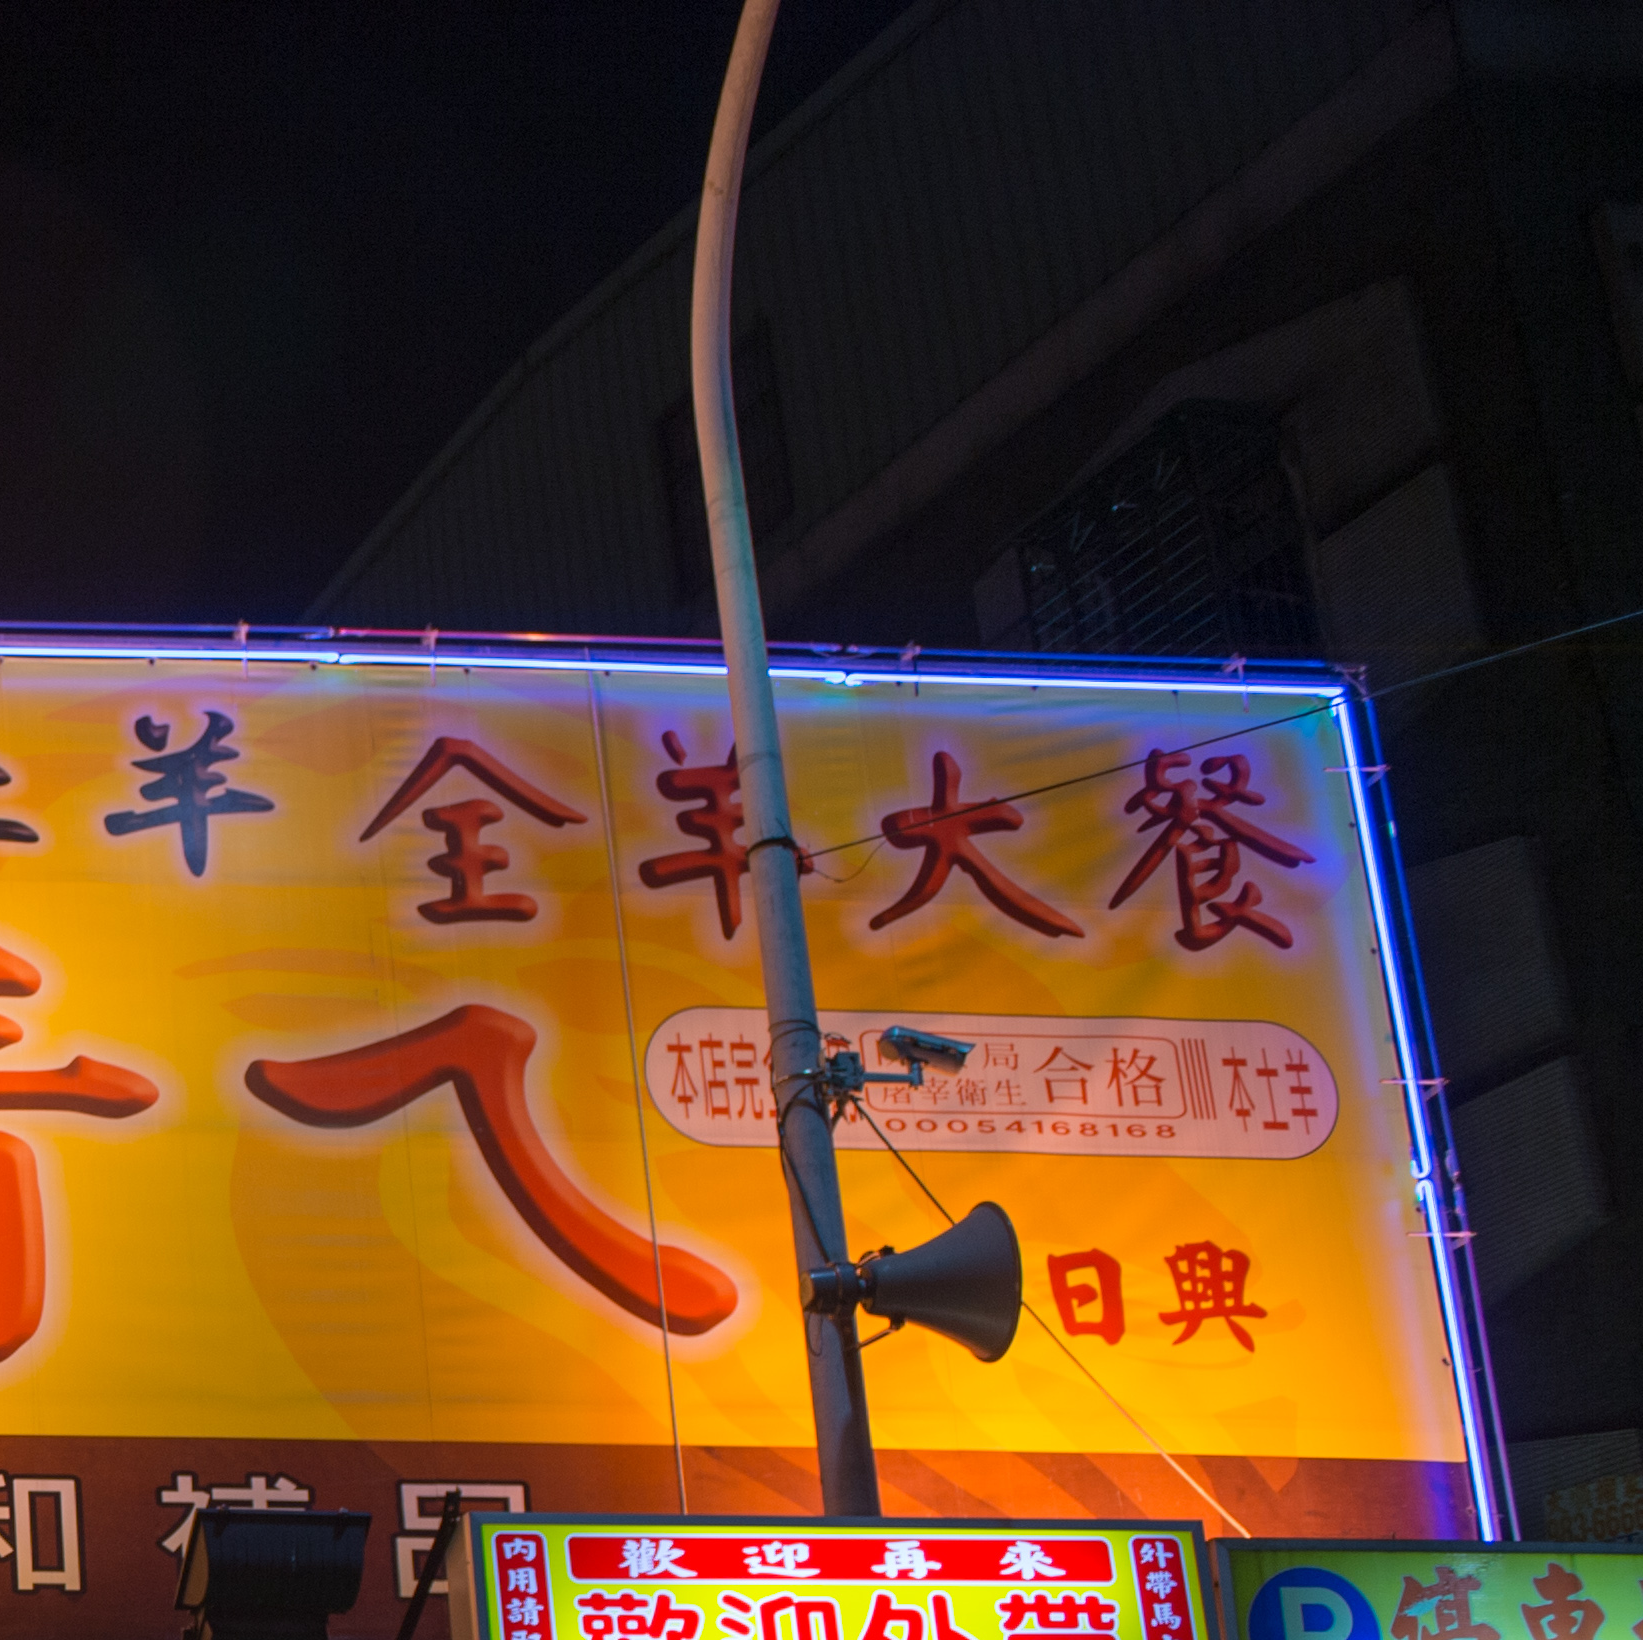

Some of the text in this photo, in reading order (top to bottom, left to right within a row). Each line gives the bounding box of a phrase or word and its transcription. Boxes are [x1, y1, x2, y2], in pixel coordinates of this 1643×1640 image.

[1032, 1045, 1168, 1108] 合格
[1221, 1046, 1318, 1136] 本土羊
[884, 1116, 1178, 1140] 00054168168
[619, 1538, 1071, 1583] 歡迎再來
